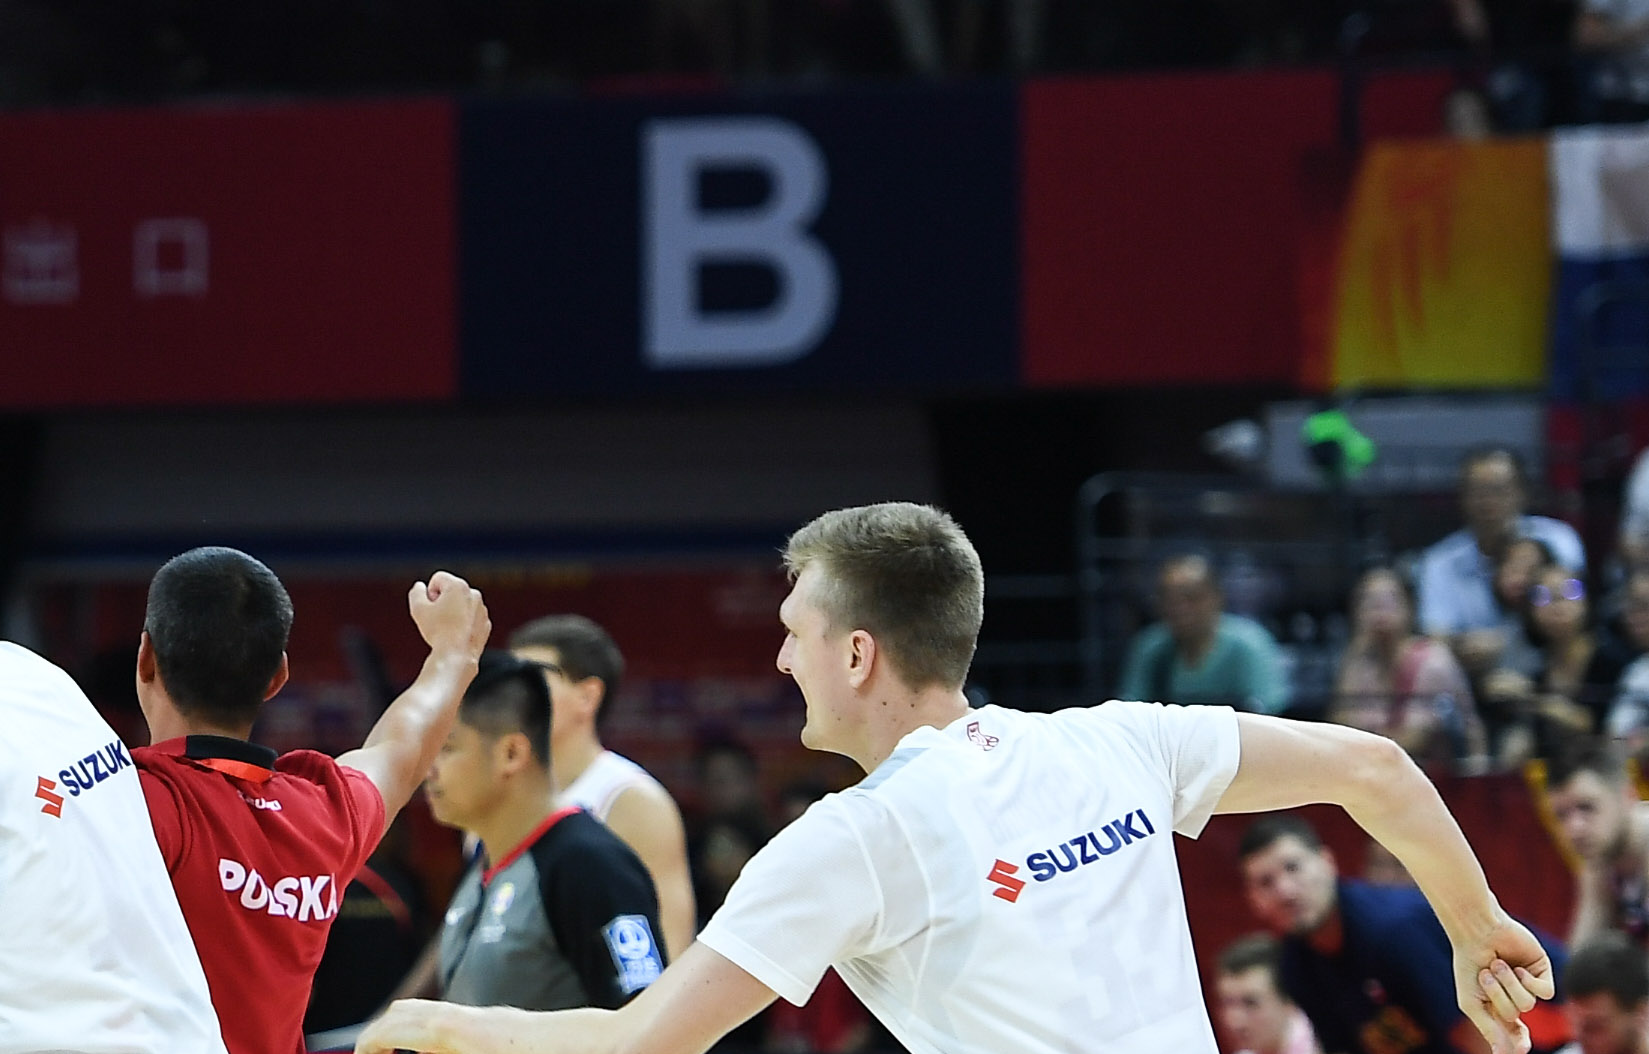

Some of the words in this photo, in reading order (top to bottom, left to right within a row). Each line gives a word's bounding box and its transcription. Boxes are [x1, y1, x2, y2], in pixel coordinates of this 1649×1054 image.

[639, 114, 840, 370] B
[58, 739, 133, 797] SUZUK
[1025, 808, 1156, 883] SUZUKI
[218, 858, 338, 922] POLSKA
